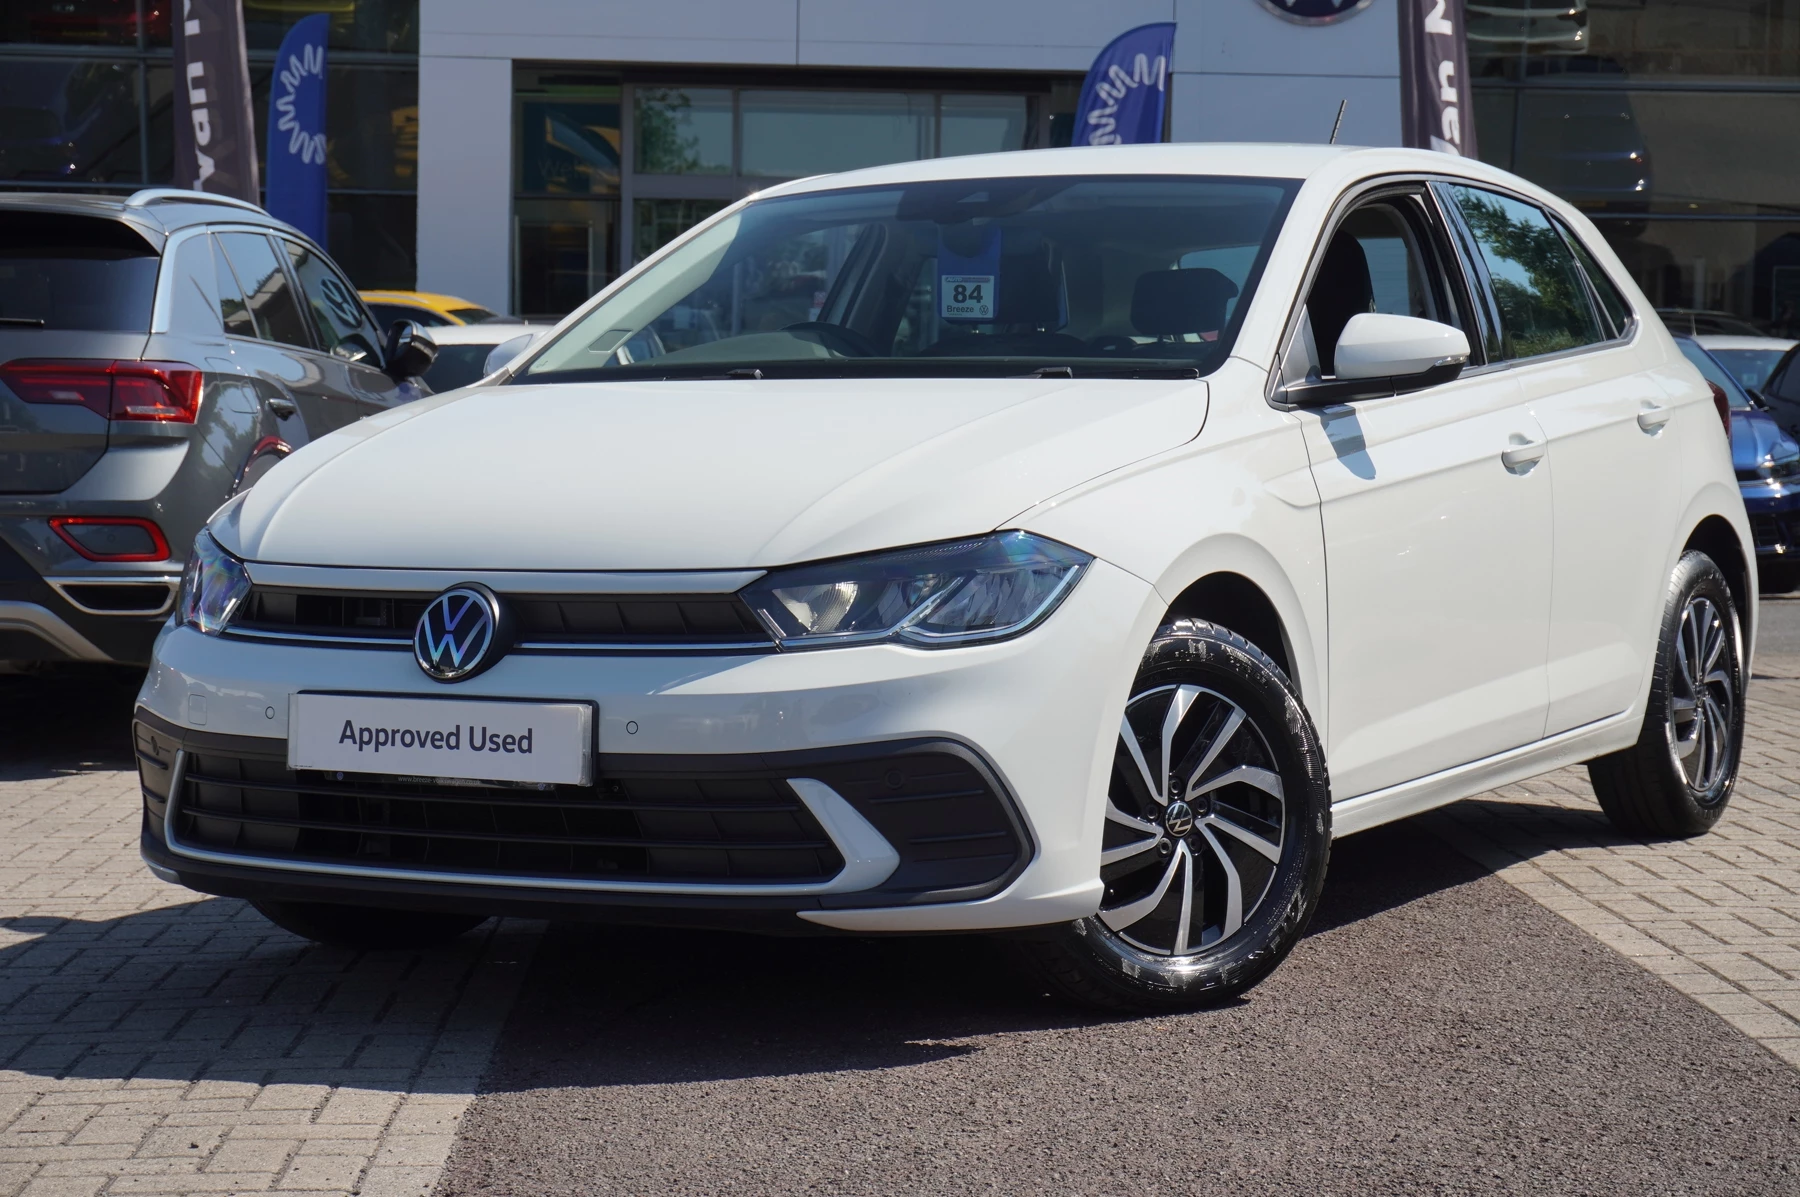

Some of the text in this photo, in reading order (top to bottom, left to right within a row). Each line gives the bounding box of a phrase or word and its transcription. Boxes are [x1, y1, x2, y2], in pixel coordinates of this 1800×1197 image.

[953, 284, 983, 304] 84
[946, 305, 975, 313] Breeze
[338, 719, 533, 754] Approved Used
